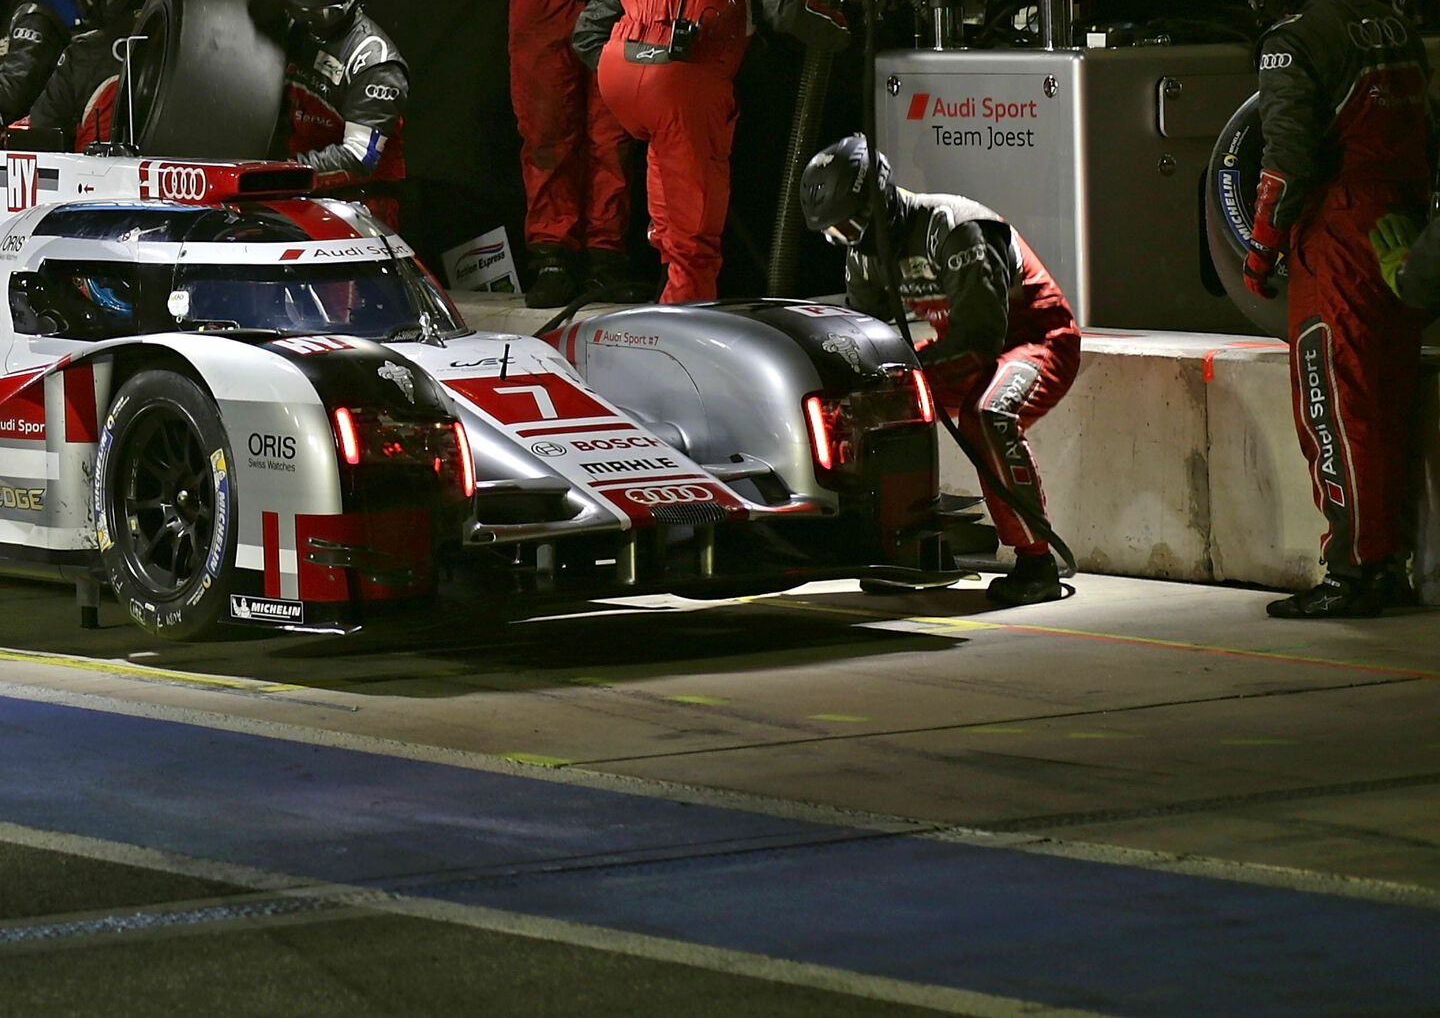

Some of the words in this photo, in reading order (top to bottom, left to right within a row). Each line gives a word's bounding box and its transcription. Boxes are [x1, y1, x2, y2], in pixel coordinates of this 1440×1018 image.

[932, 97, 976, 118] Audi
[982, 97, 1038, 123] Sport
[932, 125, 982, 147] Team
[986, 126, 1035, 150] Joest
[7, 157, 37, 210] HY
[1222, 173, 1252, 241] MICHELIN
[2, 235, 25, 252] ORIS
[314, 246, 364, 257] Audi
[478, 251, 505, 270] Express
[271, 335, 346, 355] HY
[603, 332, 622, 342] Audi
[624, 333, 647, 345] Sport
[1305, 350, 1325, 419] Sport
[493, 385, 559, 419] 7
[248, 433, 297, 459] ORIS
[571, 437, 669, 452] BOSCH
[1315, 424, 1337, 475] Audi
[95, 431, 108, 511] MICHELIN
[248, 458, 266, 470] Swiss
[267, 459, 297, 472] Watches
[580, 457, 679, 475] MAHLE
[212, 491, 226, 573] MICHELIN
[250, 602, 301, 617] MICHELIN
